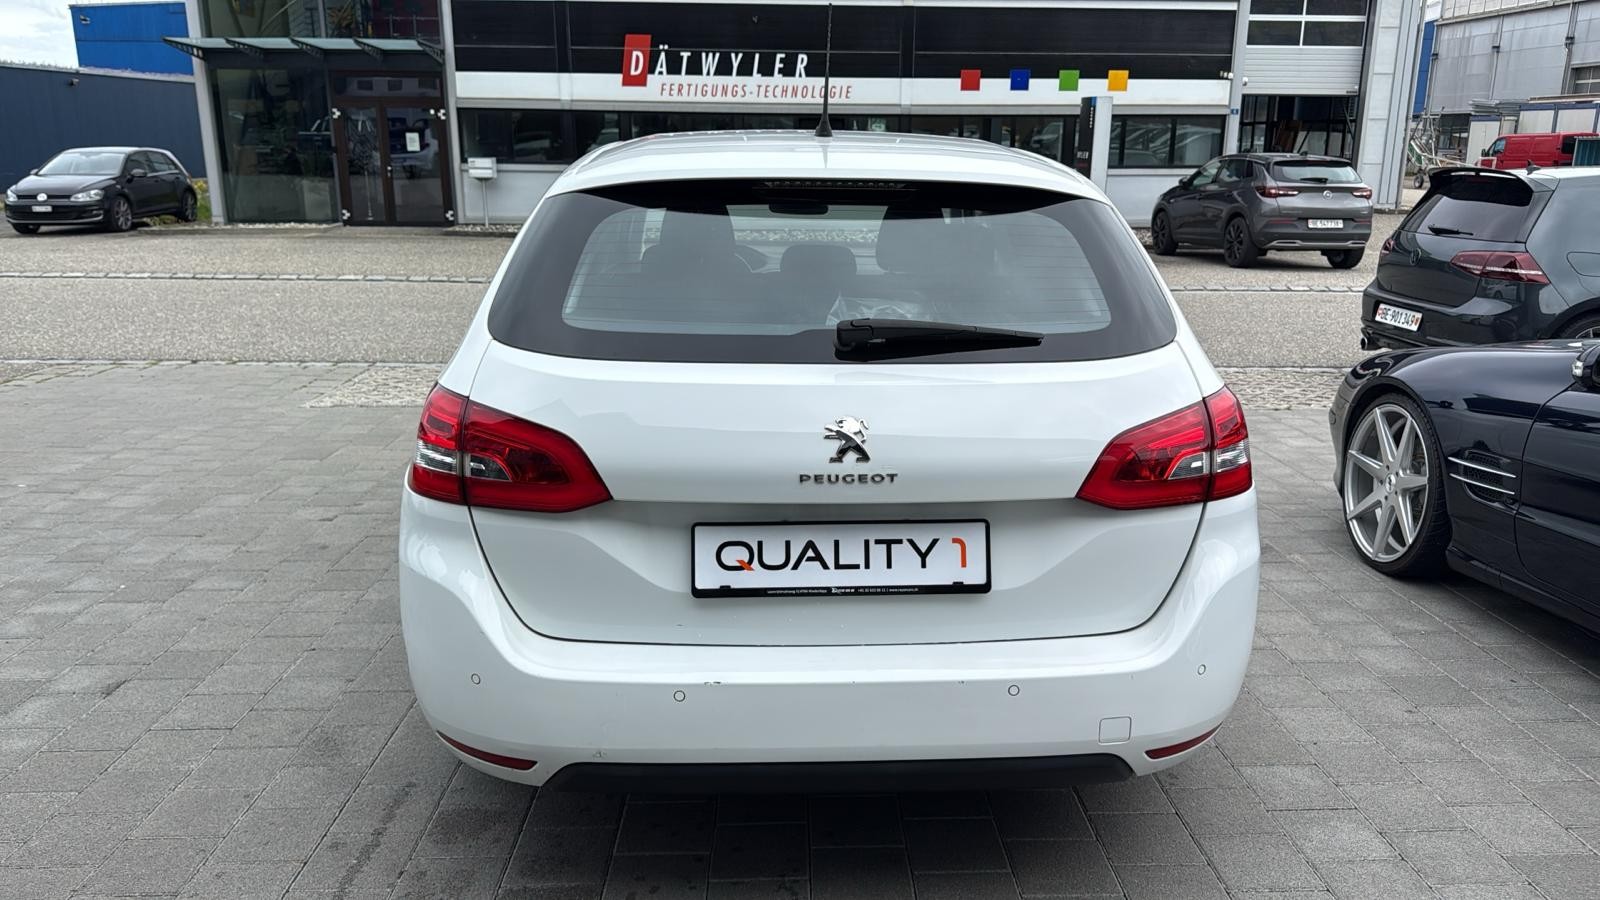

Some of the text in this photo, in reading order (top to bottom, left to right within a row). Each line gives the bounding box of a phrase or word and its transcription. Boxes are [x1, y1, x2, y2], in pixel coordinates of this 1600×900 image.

[630, 44, 808, 78] DÄTWYLER
[660, 83, 853, 99] FERTIGUNGS-TECHNOLOGIE
[799, 473, 898, 485] PEUGEOT
[715, 538, 941, 571] QUALITY
